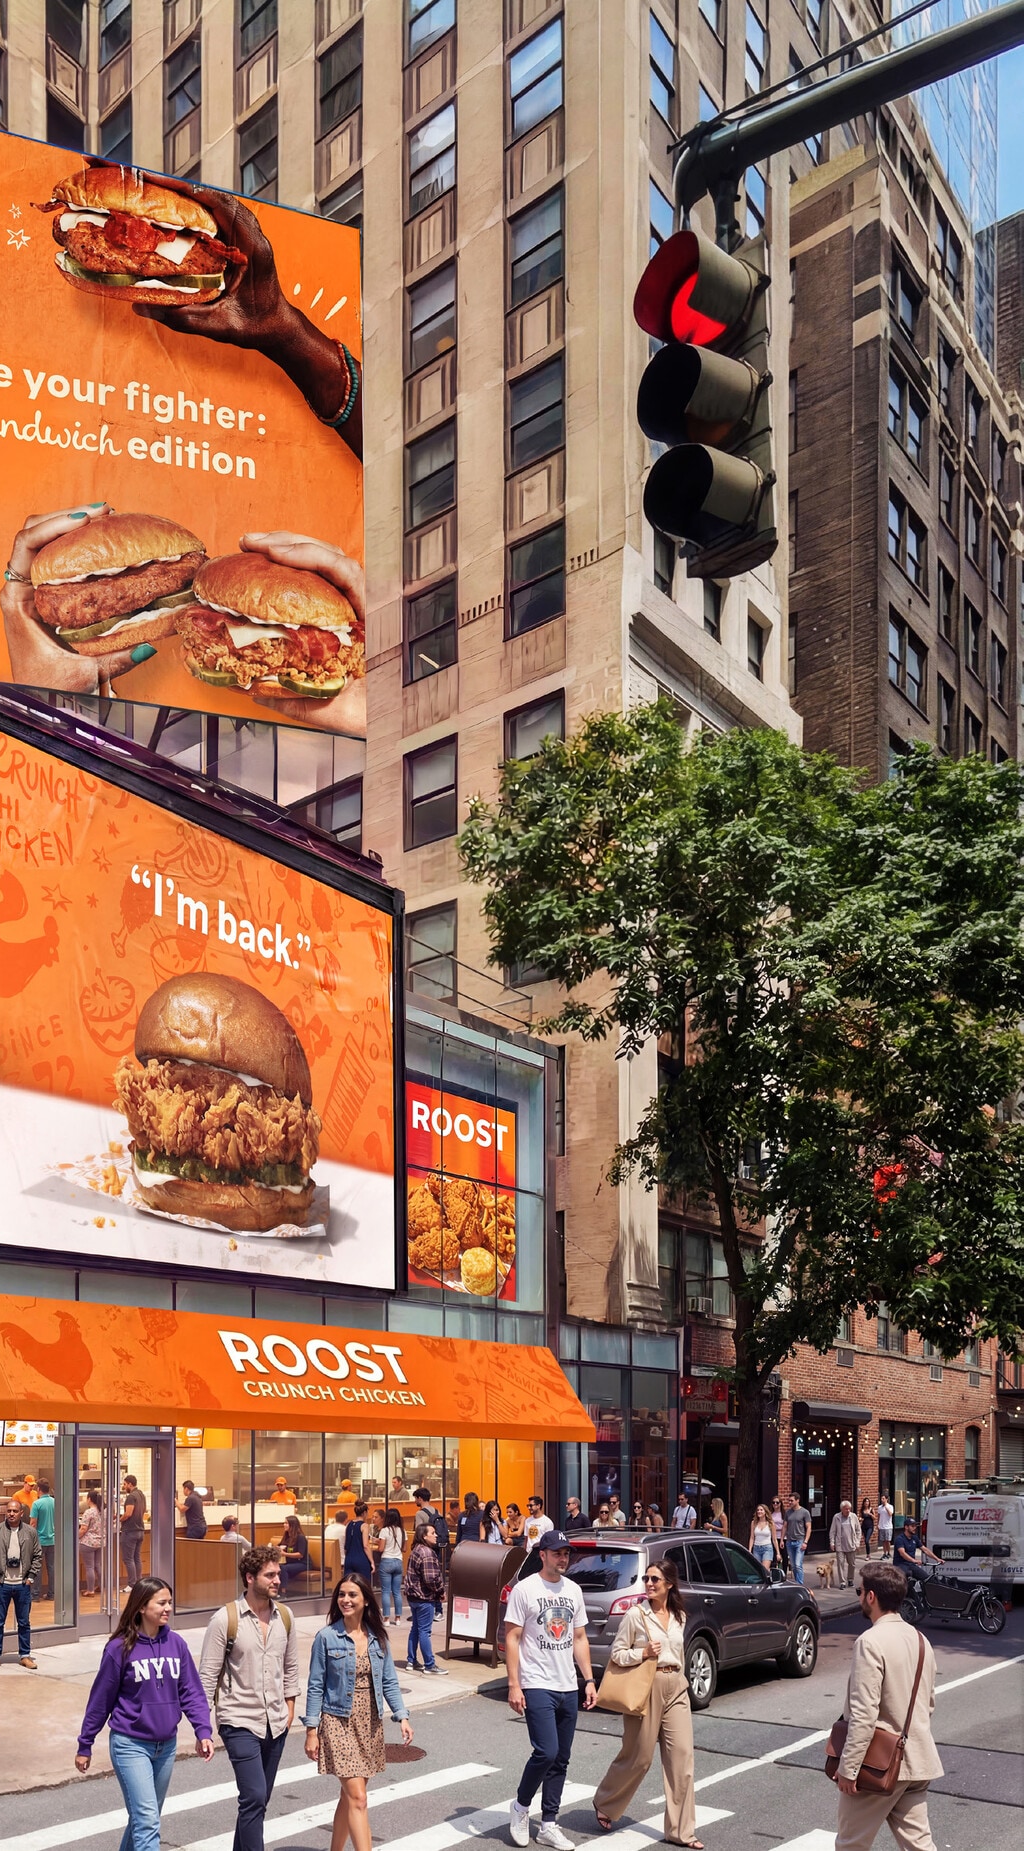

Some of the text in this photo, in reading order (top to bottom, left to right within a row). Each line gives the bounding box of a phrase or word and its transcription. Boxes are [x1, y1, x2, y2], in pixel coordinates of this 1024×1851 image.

[22, 368, 116, 406] your
[124, 380, 267, 436] fighter:
[127, 434, 257, 480] edition
[412, 1100, 509, 1152] ROOST
[217, 1330, 408, 1385] ROOST
[243, 1380, 427, 1406] CRUNCH CHICKEN
[131, 1657, 181, 1683] NYU
